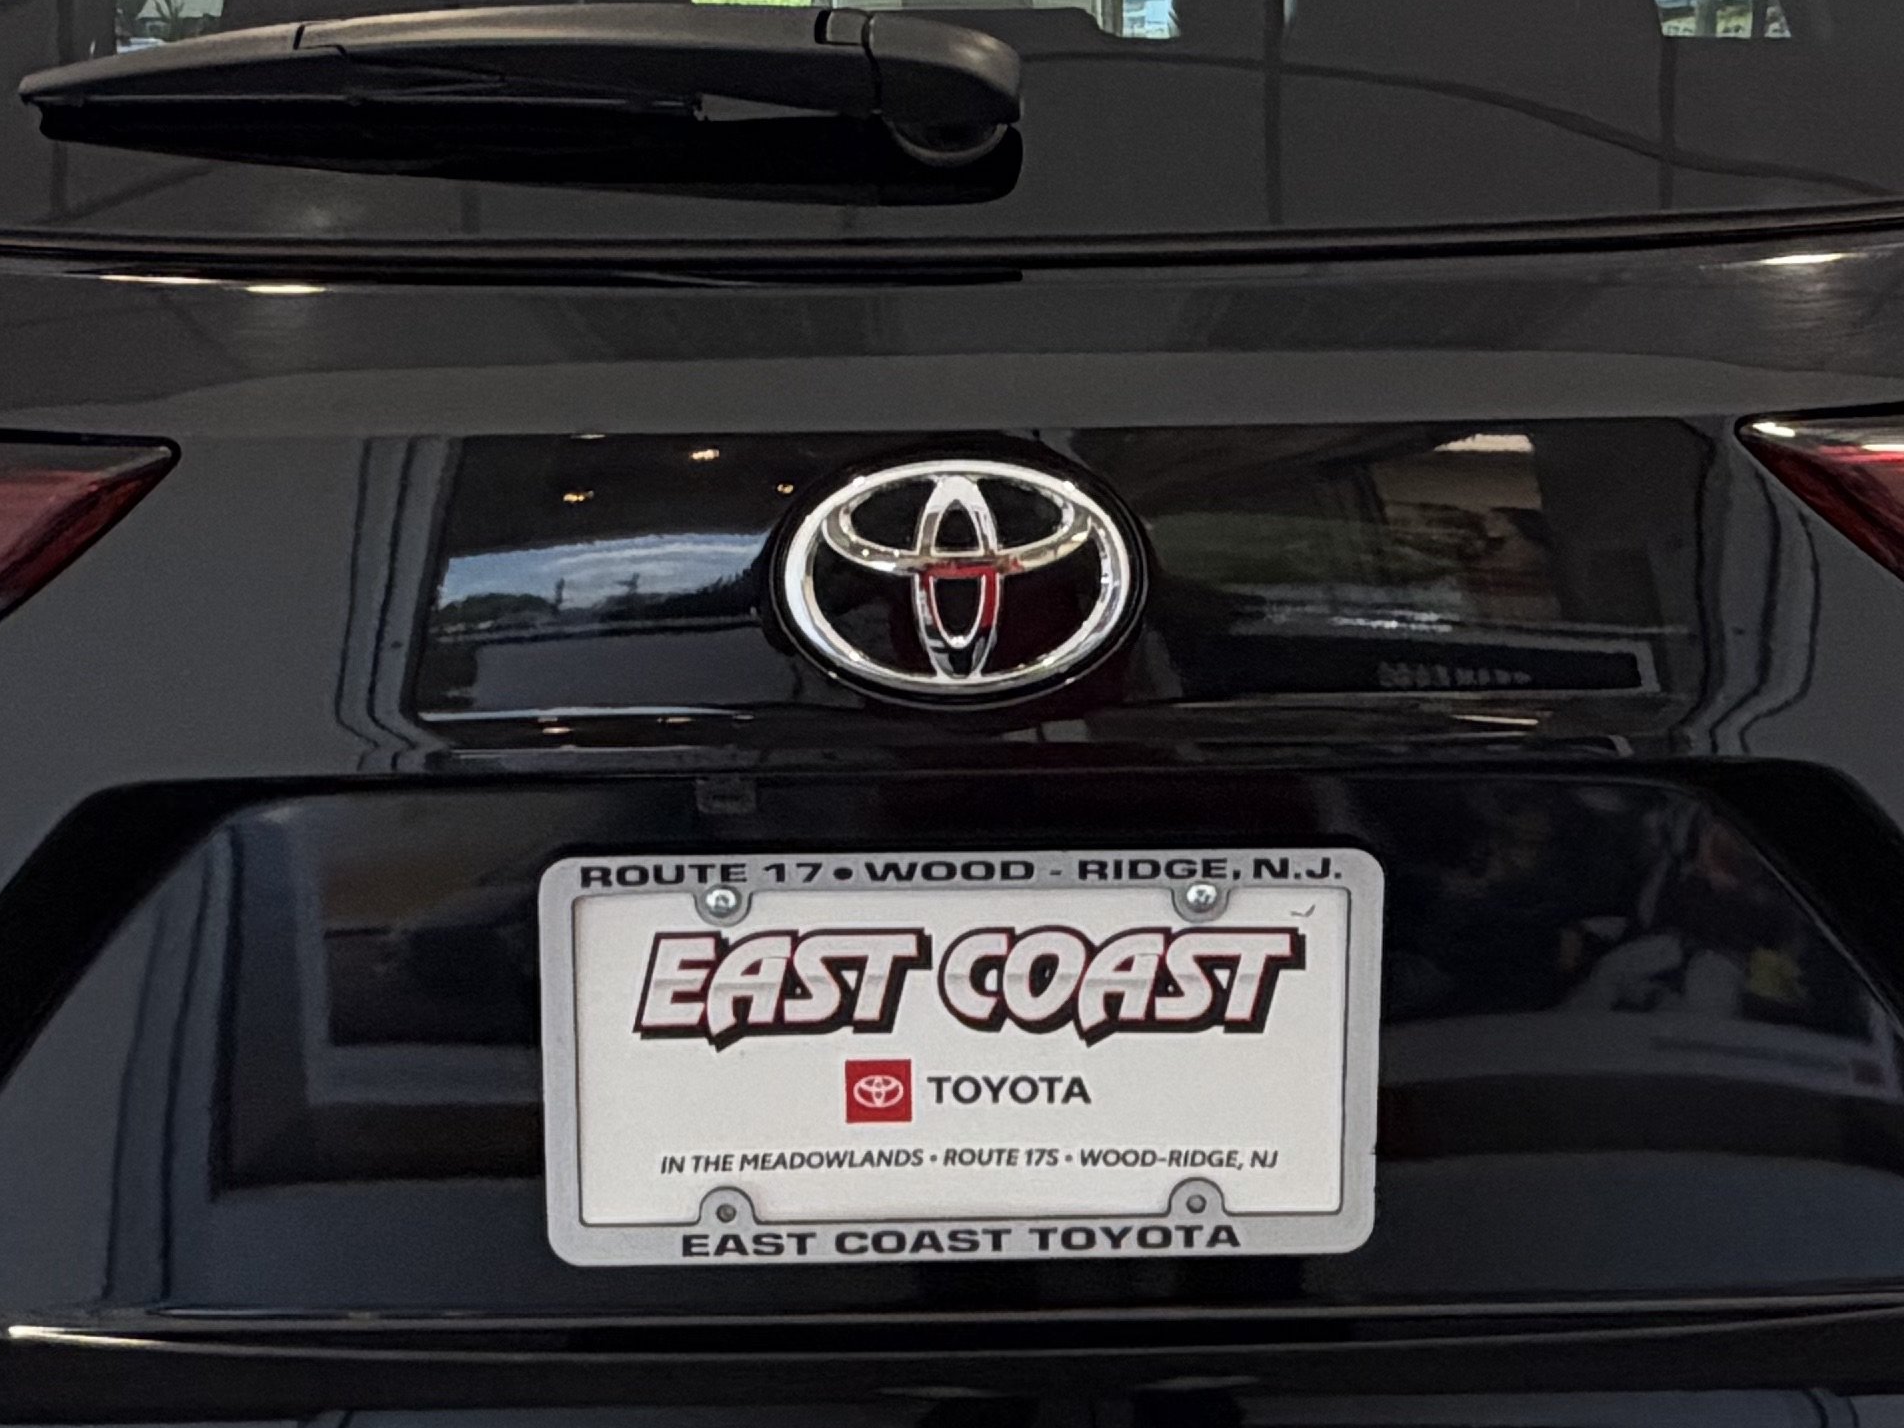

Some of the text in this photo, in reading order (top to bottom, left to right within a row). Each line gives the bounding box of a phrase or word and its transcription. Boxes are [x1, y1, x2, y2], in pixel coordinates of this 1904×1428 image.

[579, 861, 748, 889] ROUTE
[764, 862, 823, 883] 17
[864, 860, 1035, 883] WOOD
[1078, 857, 1242, 882] RIDGE,
[1252, 857, 1343, 881] N.J.
[633, 924, 1308, 1050] EAST COAST
[926, 1075, 1092, 1106] TOYOTA
[660, 1156, 687, 1176] IN
[691, 1154, 735, 1174] THE
[739, 1148, 924, 1173] MEADOWLANDS
[942, 1148, 1021, 1169] ROUTE
[1080, 1148, 1245, 1172] WOOD-RIDGE,
[1250, 1149, 1280, 1170] NJ
[681, 1223, 1241, 1259] EAST COAST TOYOTA
